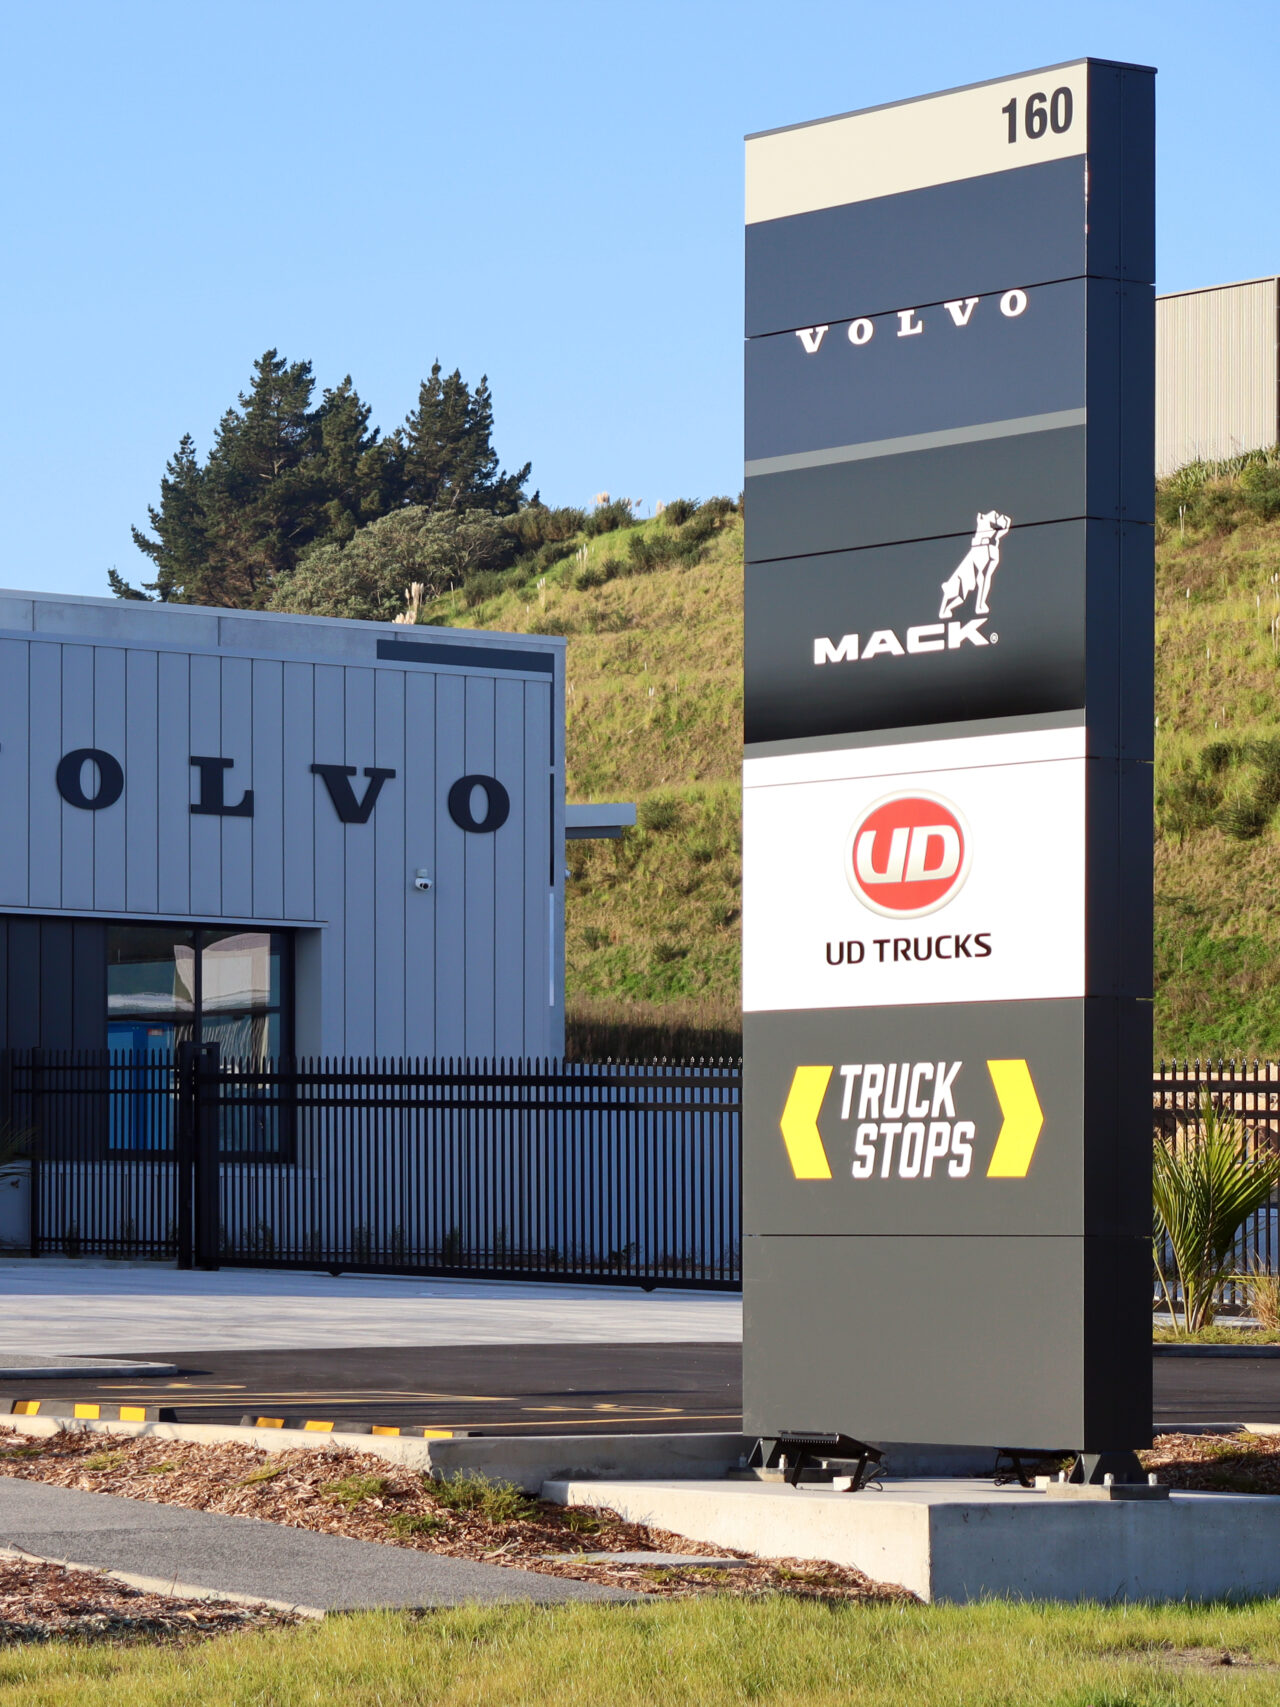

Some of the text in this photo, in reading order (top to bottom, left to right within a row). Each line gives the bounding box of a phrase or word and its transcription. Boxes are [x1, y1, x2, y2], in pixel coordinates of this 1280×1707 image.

[1002, 86, 1073, 143] 160
[796, 289, 1028, 353] VOLVO
[856, 824, 961, 884] UD
[826, 933, 992, 965] UD TRUCKS
[839, 1061, 962, 1120] TRUCK
[851, 1121, 976, 1179] STOPS
